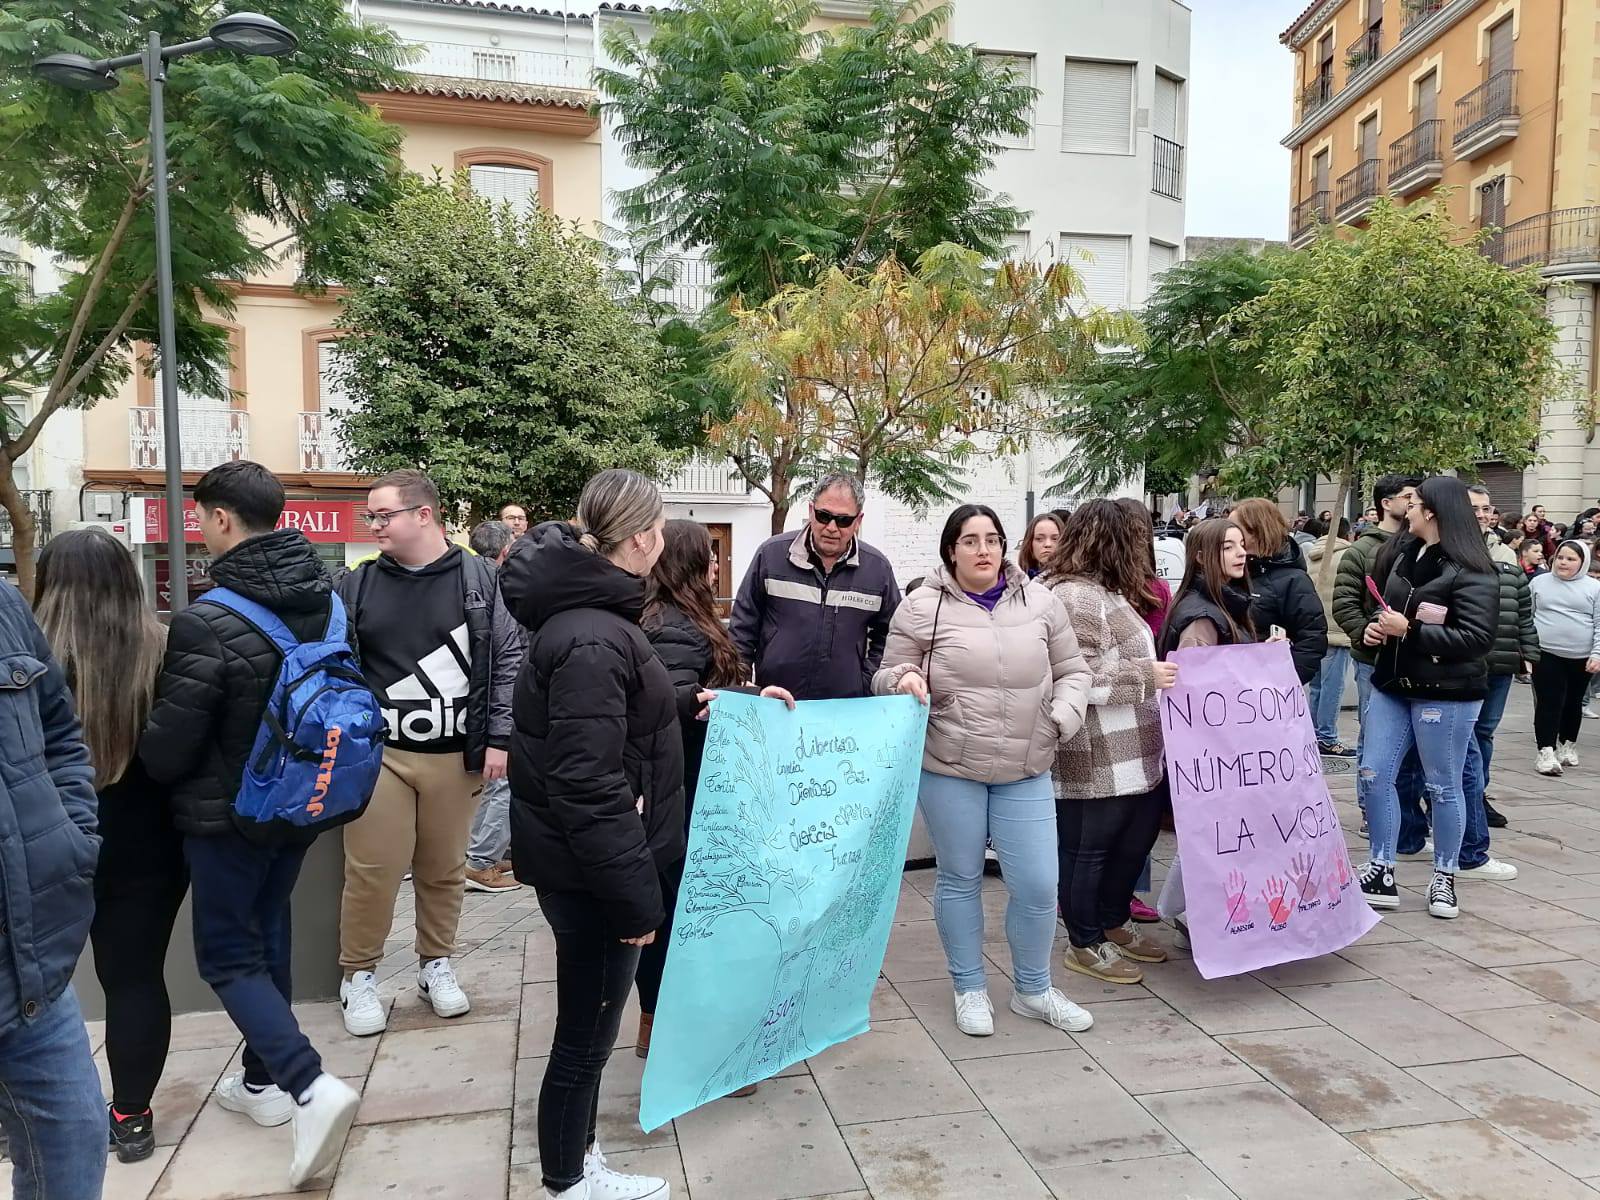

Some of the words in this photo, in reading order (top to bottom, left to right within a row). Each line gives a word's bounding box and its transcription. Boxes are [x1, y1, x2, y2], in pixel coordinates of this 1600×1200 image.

[380, 697, 467, 742] adi
[1167, 691, 1227, 731] NO
[1174, 748, 1295, 795] NÚMERO
[1216, 818, 1256, 855] LA
[1271, 802, 1329, 844] VOZ
